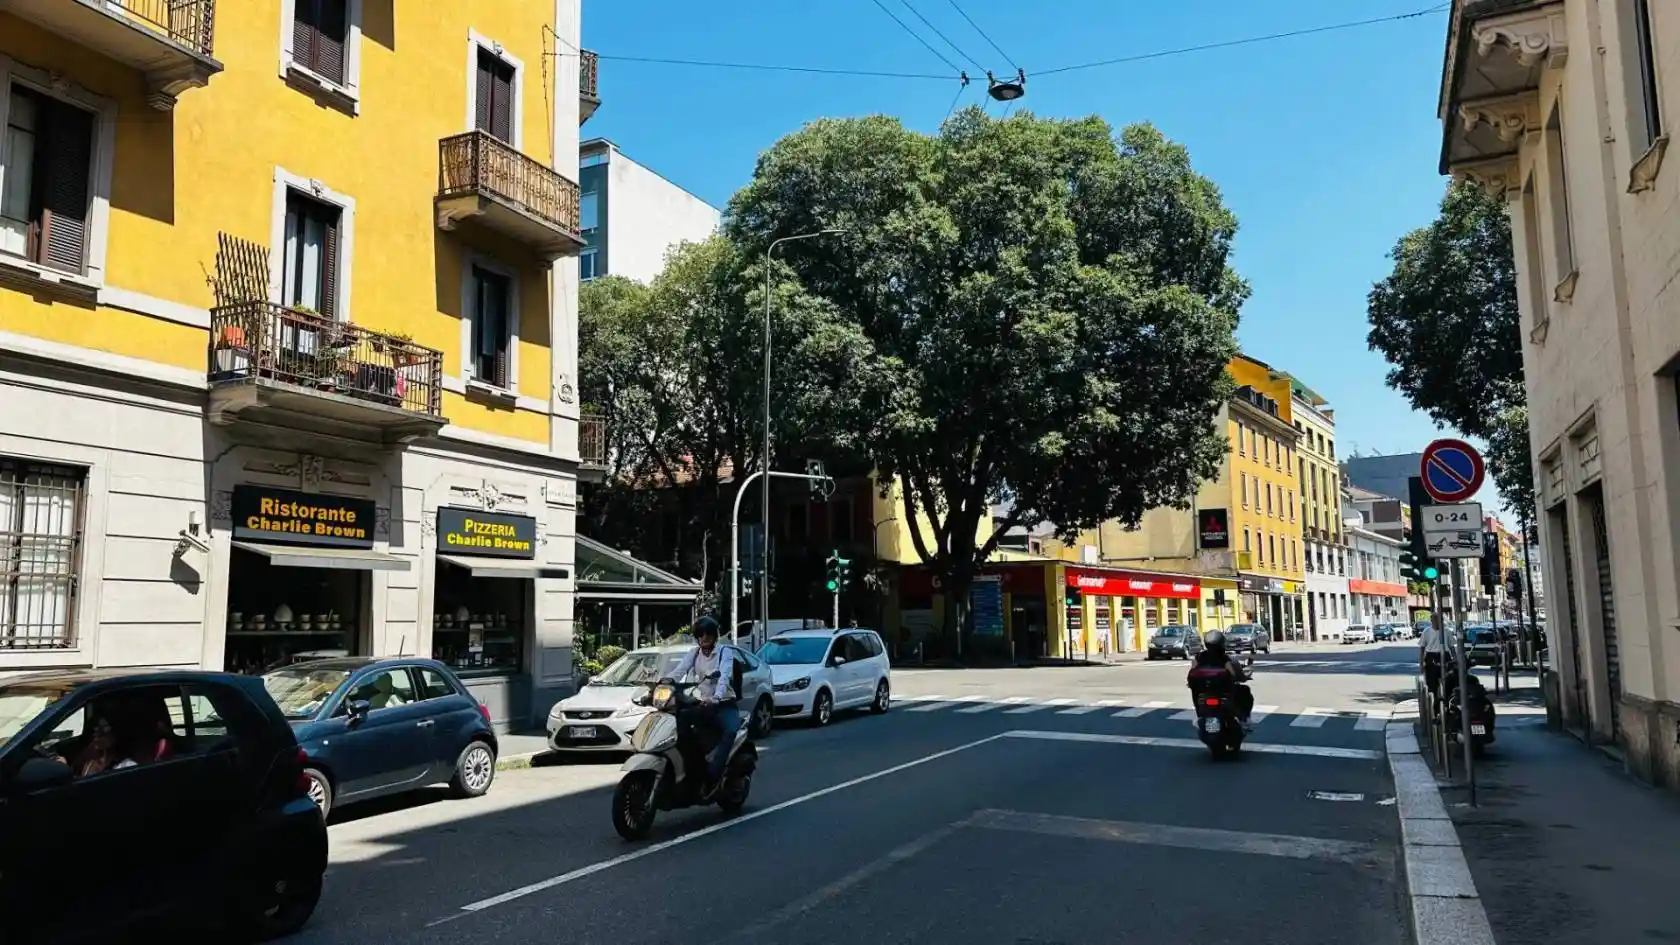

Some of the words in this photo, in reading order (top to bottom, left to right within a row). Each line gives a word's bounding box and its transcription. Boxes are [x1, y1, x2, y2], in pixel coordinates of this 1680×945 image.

[259, 497, 356, 524] Ristorante
[1435, 512, 1468, 522] 0-24
[247, 516, 311, 535] Charlie
[315, 523, 366, 539] Brown
[464, 518, 516, 537] PIZZERIA
[447, 533, 492, 548] Charlie
[494, 536, 530, 551] Brown
